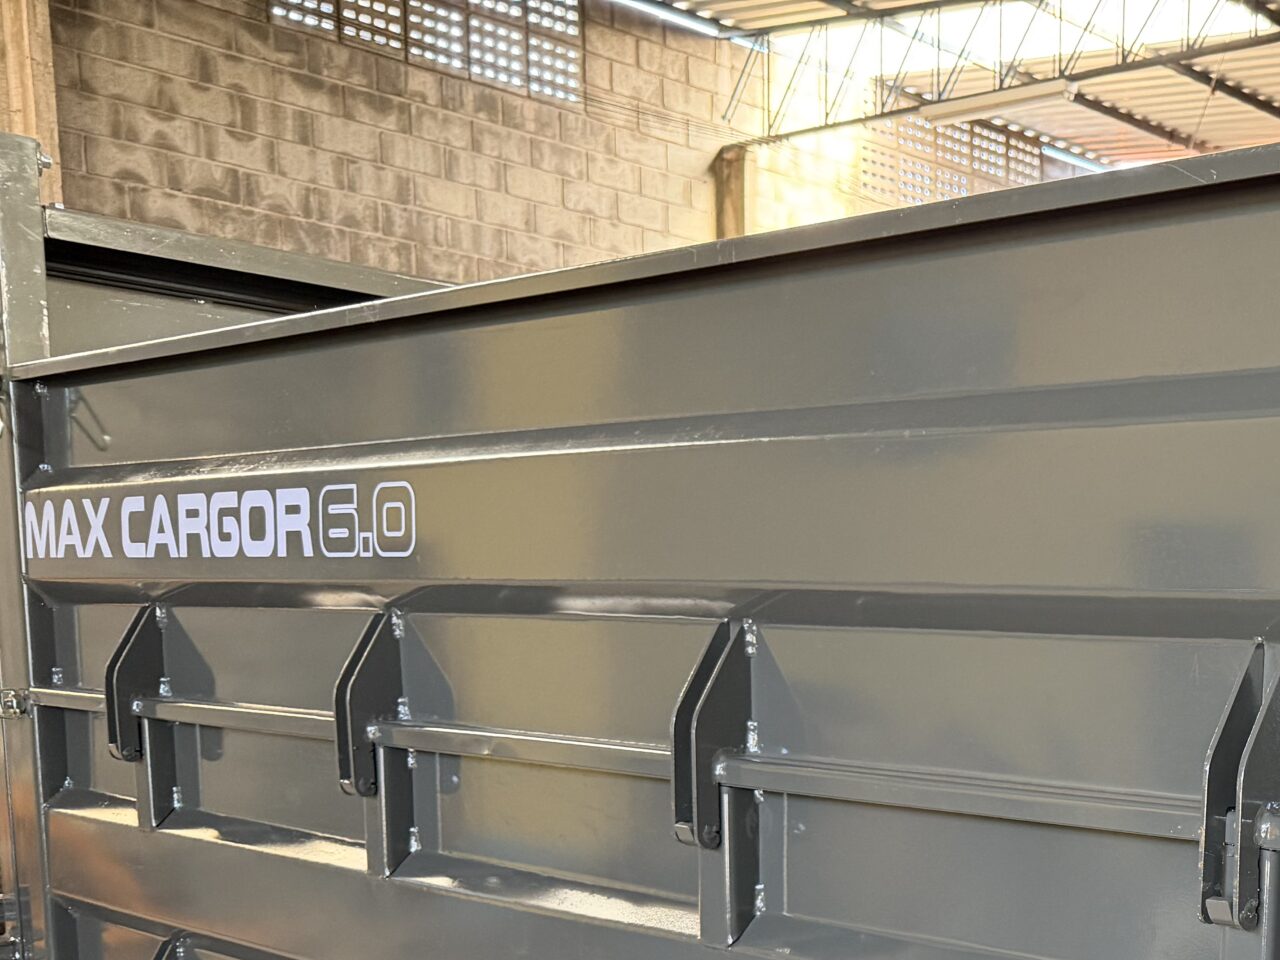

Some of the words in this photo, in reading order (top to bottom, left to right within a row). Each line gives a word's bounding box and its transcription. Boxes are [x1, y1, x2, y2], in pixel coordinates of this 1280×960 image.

[25, 498, 113, 558] MAX
[121, 488, 314, 558] CARGOR
[319, 481, 416, 558] 6.0
